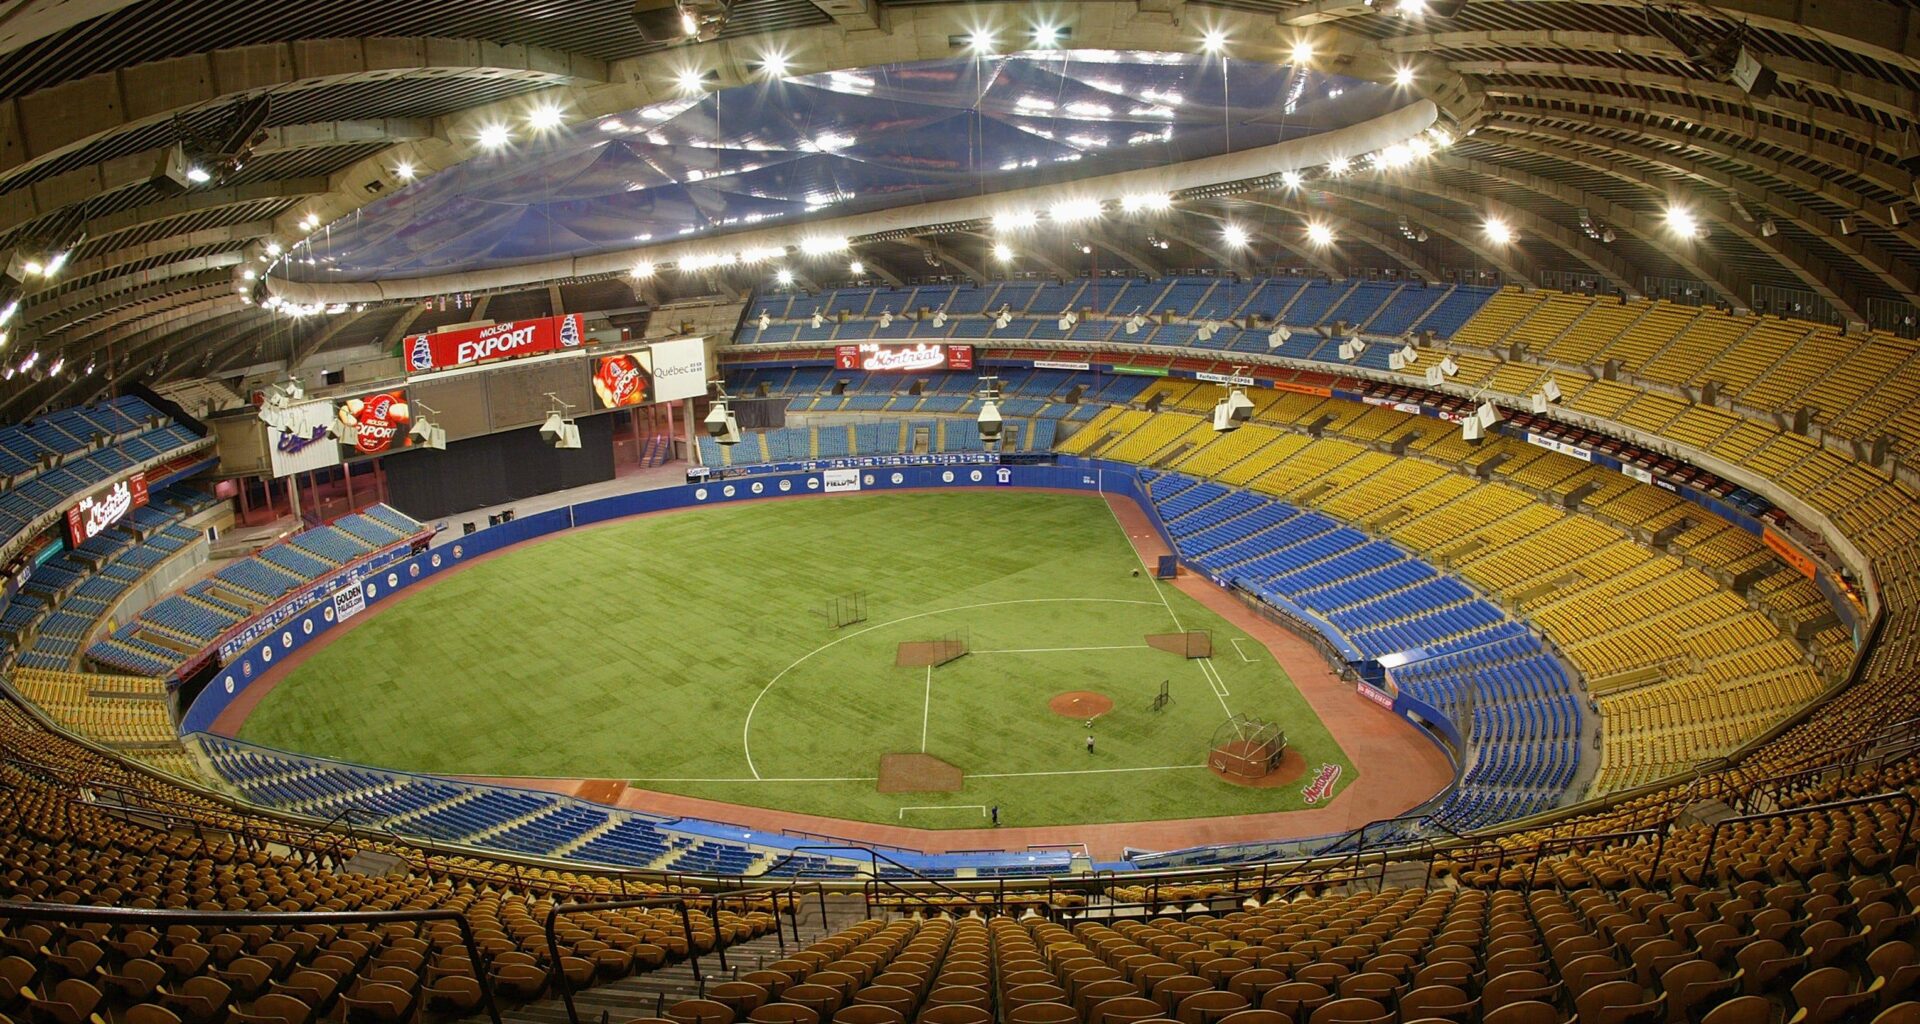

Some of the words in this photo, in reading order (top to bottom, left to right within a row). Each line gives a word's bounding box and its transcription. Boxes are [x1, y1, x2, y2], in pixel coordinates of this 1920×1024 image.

[480, 322, 514, 338] MOLSON
[458, 326, 536, 364] EXPORT
[654, 365, 689, 379] Québec
[336, 586, 361, 606] GOLDEN
